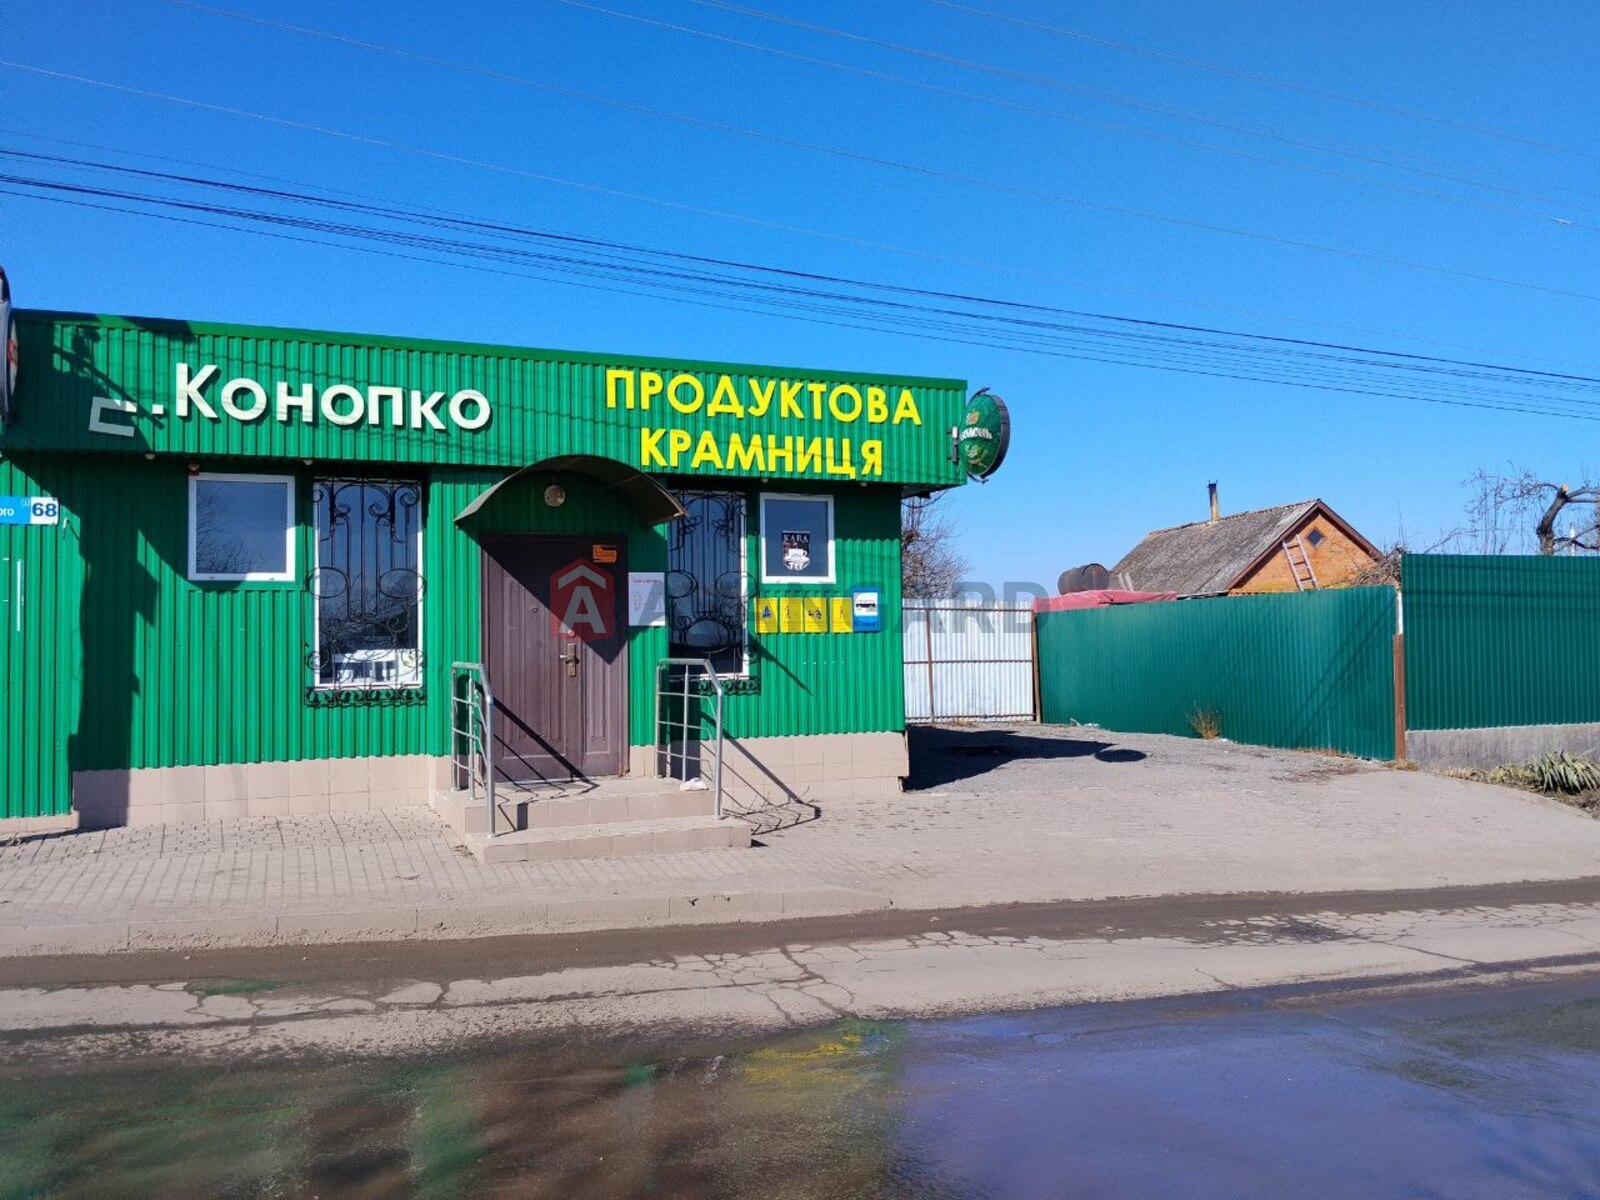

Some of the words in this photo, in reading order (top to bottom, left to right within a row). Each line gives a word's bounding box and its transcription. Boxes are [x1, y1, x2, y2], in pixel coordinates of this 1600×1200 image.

[606, 369, 921, 426] ПРОДУКТОВА
[640, 428, 883, 479] КРАМНИЦЯ
[32, 503, 57, 517] 68
